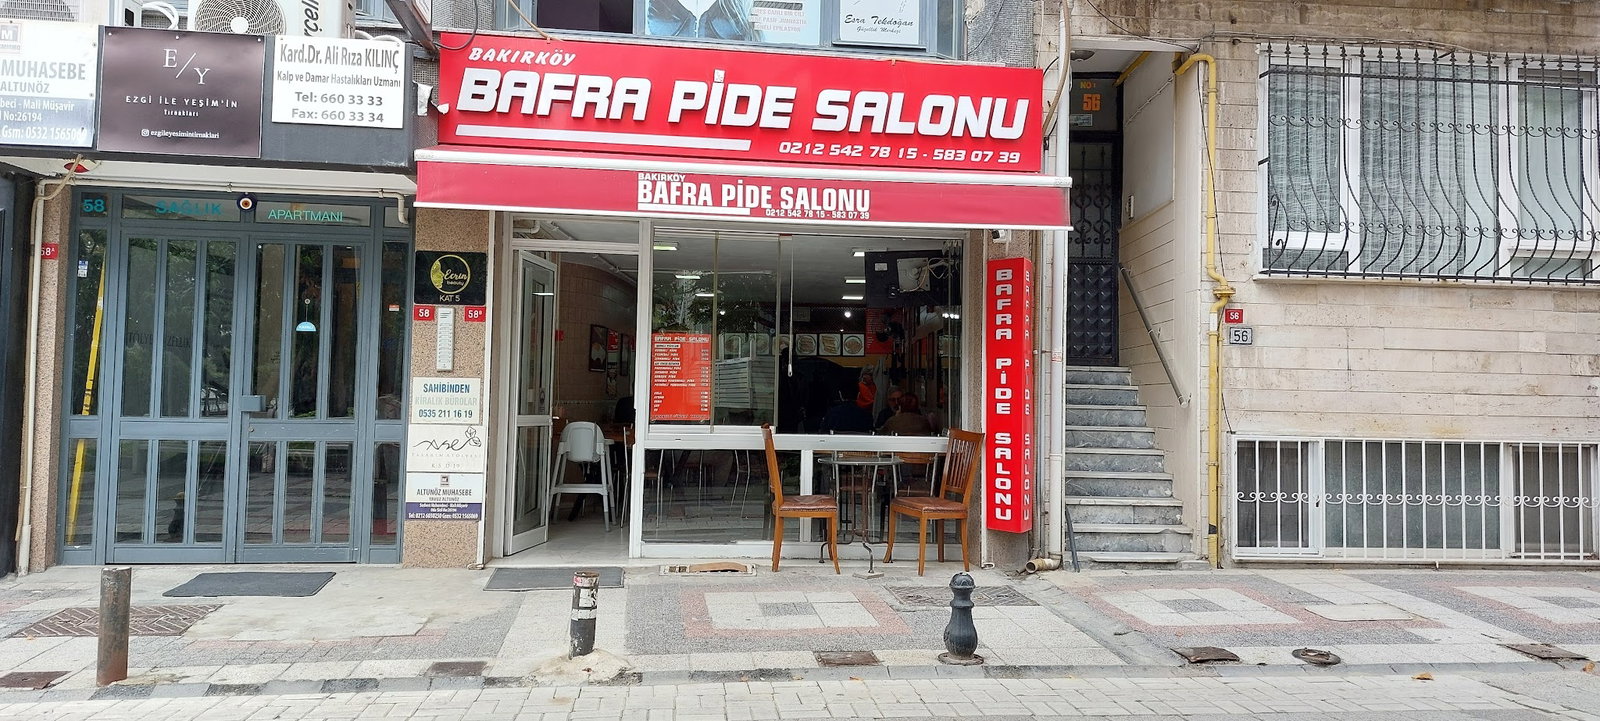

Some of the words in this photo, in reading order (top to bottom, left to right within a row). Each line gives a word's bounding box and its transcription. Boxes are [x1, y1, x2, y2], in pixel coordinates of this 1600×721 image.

[844, 15, 866, 24] Esra
[871, 16, 914, 28] Tekdoğan
[280, 44, 322, 64] Kard.Dr.
[325, 46, 339, 65] Ali
[341, 47, 362, 66] Rıza
[365, 48, 399, 74] KILINÇ
[468, 47, 577, 66] BAKIRKÖY
[1, 60, 86, 80] MUHASEBE
[277, 70, 294, 84] Kalp
[295, 74, 304, 82] ve
[305, 72, 329, 83] Damar
[331, 73, 372, 86] Hastalıkları
[374, 76, 401, 88] Uzmanı
[0, 80, 50, 94] ALTUNÖZ
[23, 99, 41, 110] Mali
[42, 101, 75, 114] Müşavir
[126, 95, 152, 104] EZGİ
[160, 96, 177, 105] İLE
[184, 98, 239, 108] YEŞİM'İN
[295, 92, 317, 103] Tel:
[320, 94, 344, 104] 660
[348, 95, 363, 105] 33
[367, 96, 383, 106] 33
[456, 67, 652, 122] BAFRA
[667, 69, 798, 130] PİDE
[811, 88, 1030, 140] SALONU
[1083, 94, 1101, 111] 56
[4, 111, 42, 123] No:26194
[292, 108, 318, 119] Fax:
[321, 110, 345, 121] 660
[349, 111, 364, 122] 33
[368, 112, 384, 123] 34
[2, 125, 24, 139] Gsm:
[26, 126, 49, 140] 0532
[779, 141, 824, 155] 0212
[829, 143, 862, 157] 542
[869, 145, 891, 158] 78
[898, 147, 918, 159] 15
[933, 148, 966, 161] 583
[970, 150, 994, 162] 07
[998, 151, 1021, 164] 39
[637, 180, 713, 206] BAFRA
[721, 179, 772, 209] PİDE
[780, 187, 870, 212] SALONU
[82, 199, 105, 213] 58
[155, 200, 222, 216] SAĞLIK
[765, 208, 785, 217] 0212
[787, 209, 802, 218] 542
[804, 209, 814, 218] 78
[816, 210, 825, 218] 15
[831, 210, 846, 219] 583
[848, 210, 858, 219] 07
[860, 211, 870, 220] 39
[444, 269, 468, 281] Ecrin
[995, 269, 1013, 340] BAFRA
[418, 309, 430, 318] 58
[1230, 312, 1240, 320] 56
[1234, 330, 1249, 342] 56
[423, 382, 470, 393] SAHİBİNDEN
[995, 358, 1013, 415] PİDE
[418, 409, 436, 418] 0535
[438, 409, 451, 418] 211
[454, 410, 462, 418] 16
[464, 410, 473, 419] 19
[995, 432, 1012, 521] SALONU
[416, 488, 441, 496] ALTUNÖZ
[442, 488, 472, 496] MUHASEBE
